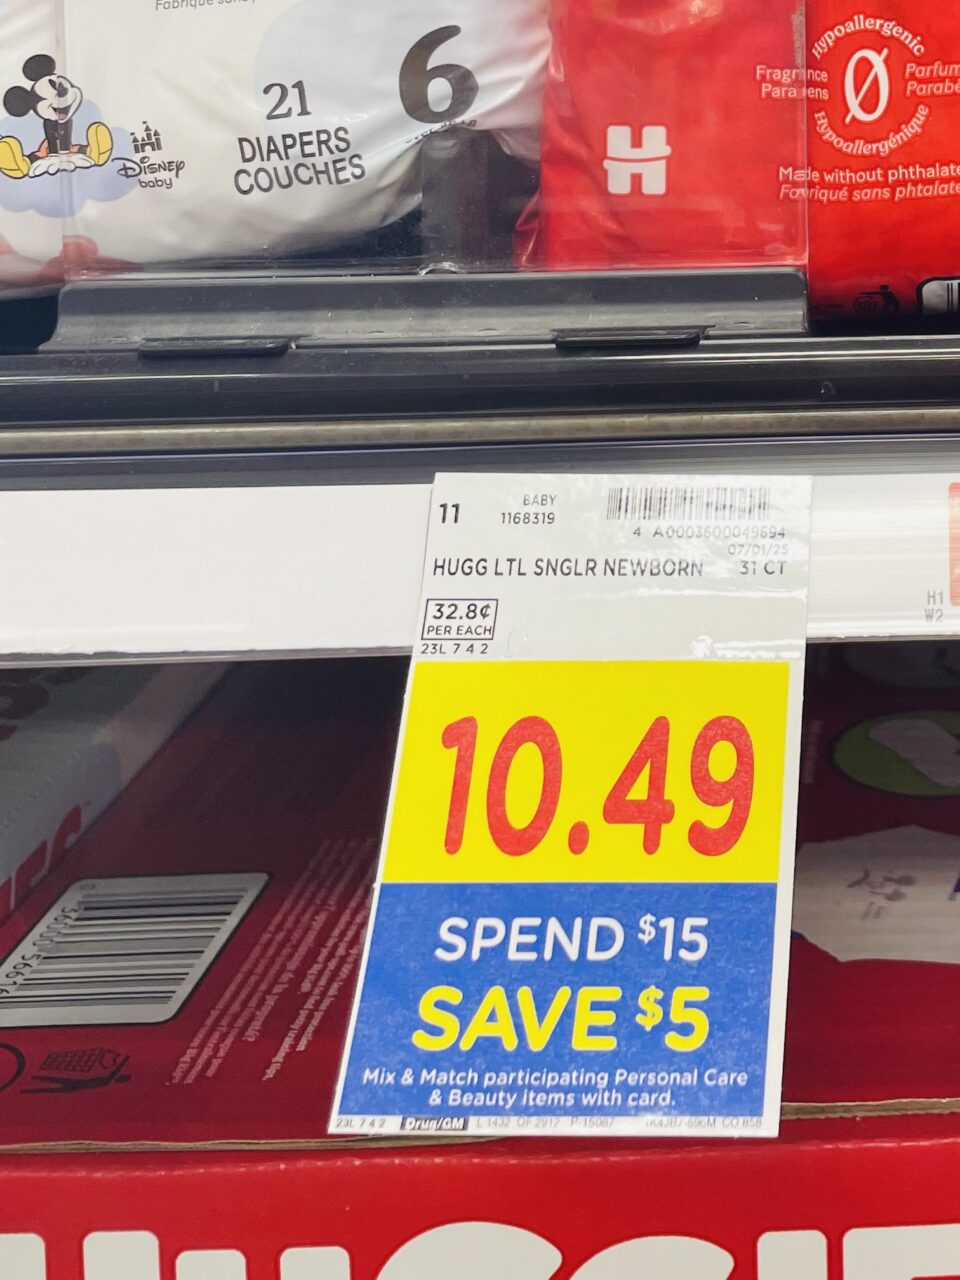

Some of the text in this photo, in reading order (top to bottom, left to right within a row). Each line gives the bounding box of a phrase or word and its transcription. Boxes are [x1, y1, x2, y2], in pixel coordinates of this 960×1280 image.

[811, 14, 926, 61] Hypoallergenic
[399, 24, 480, 124] 6
[262, 80, 313, 120] 21
[814, 103, 929, 157] Hypoallergénique
[237, 126, 352, 164] DIAPERS
[138, 177, 174, 190] baby
[233, 154, 366, 196] COUCHES
[823, 167, 884, 185] without
[852, 184, 891, 202] sans
[438, 494, 557, 524] 11 BABY
[501, 511, 556, 526] 1168319
[433, 558, 788, 577] HUGG LTL SNGLR NEWBORN 31 CT
[433, 603, 491, 621] 32.8¢
[427, 625, 493, 637] PER EACH
[421, 644, 447, 655] 23L
[441, 715, 755, 857] 10.49
[435, 913, 709, 962] SPEND $15
[412, 985, 710, 1052] SAVE $5
[363, 1069, 394, 1085] Mix
[420, 1068, 477, 1086] Match
[483, 1068, 608, 1091] participating
[614, 1068, 697, 1086] Personal
[704, 1070, 748, 1086] Care
[428, 1086, 676, 1111] & Beauty items with card.
